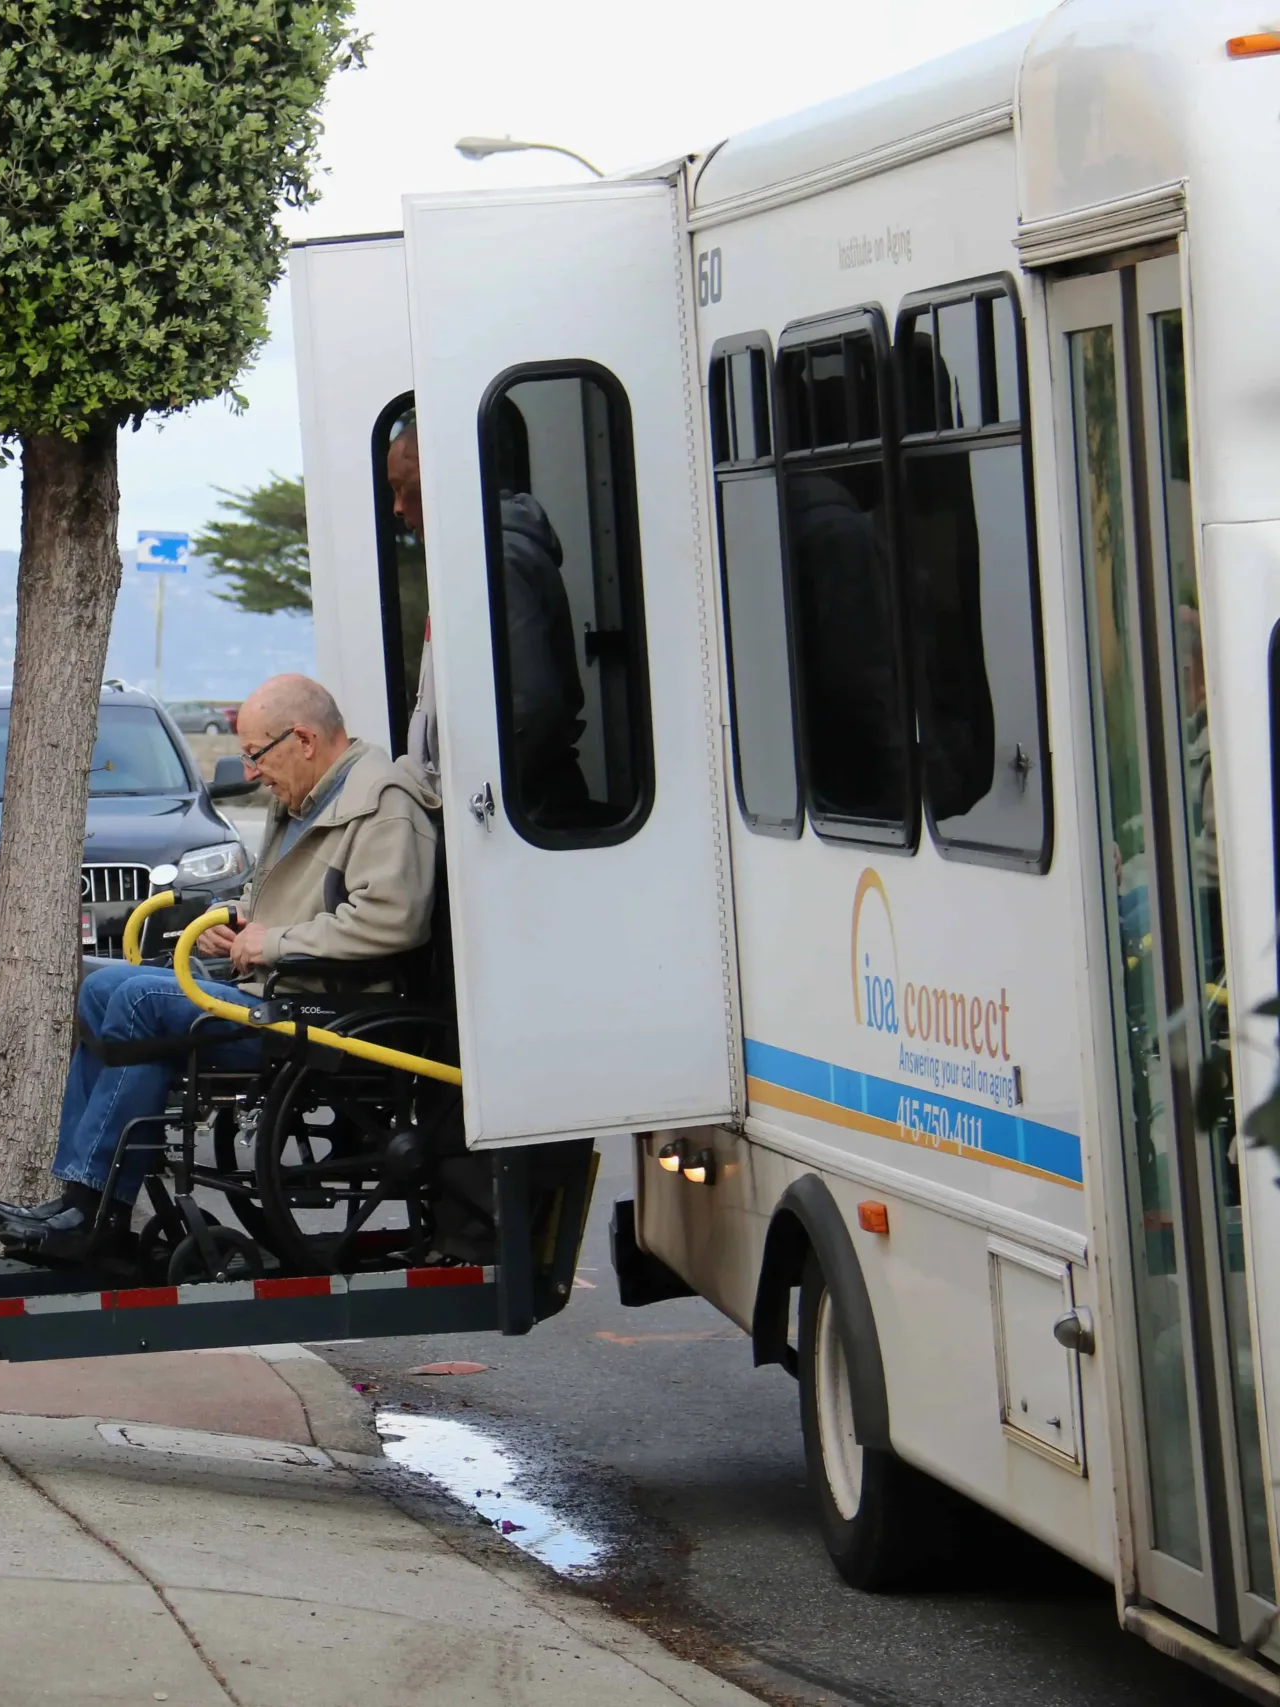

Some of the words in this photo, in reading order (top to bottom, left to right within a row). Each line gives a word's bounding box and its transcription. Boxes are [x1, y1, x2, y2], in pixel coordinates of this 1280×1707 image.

[698, 246, 722, 307] 60
[838, 234, 872, 270] Institute
[874, 236, 885, 262] on
[886, 222, 912, 265] Aging
[864, 953, 899, 1034] ioa
[904, 982, 1011, 1062] connect
[899, 1041, 940, 1088] Answering
[941, 1060, 959, 1090] your
[961, 1060, 976, 1091] call
[978, 1070, 988, 1094] on
[989, 1066, 1013, 1109] aging
